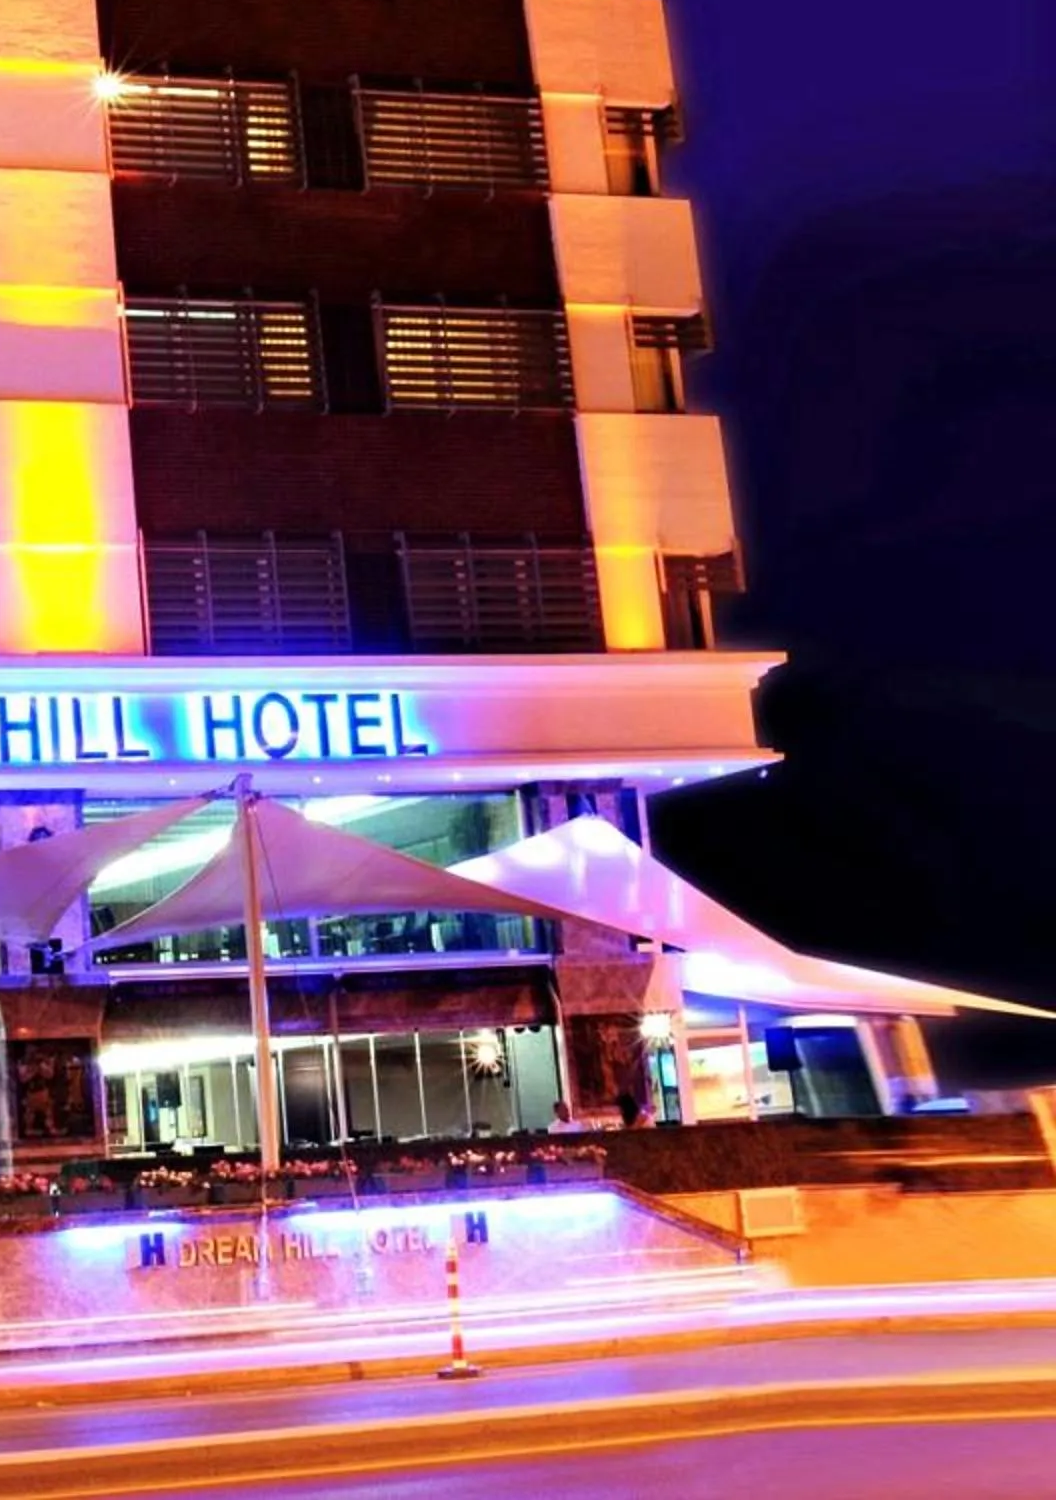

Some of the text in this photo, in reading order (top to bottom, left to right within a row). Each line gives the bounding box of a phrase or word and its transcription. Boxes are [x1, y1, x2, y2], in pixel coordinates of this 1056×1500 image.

[203, 692, 428, 759] HOTEL
[179, 1232, 273, 1268] DREAM
[281, 1230, 340, 1262] HILL
